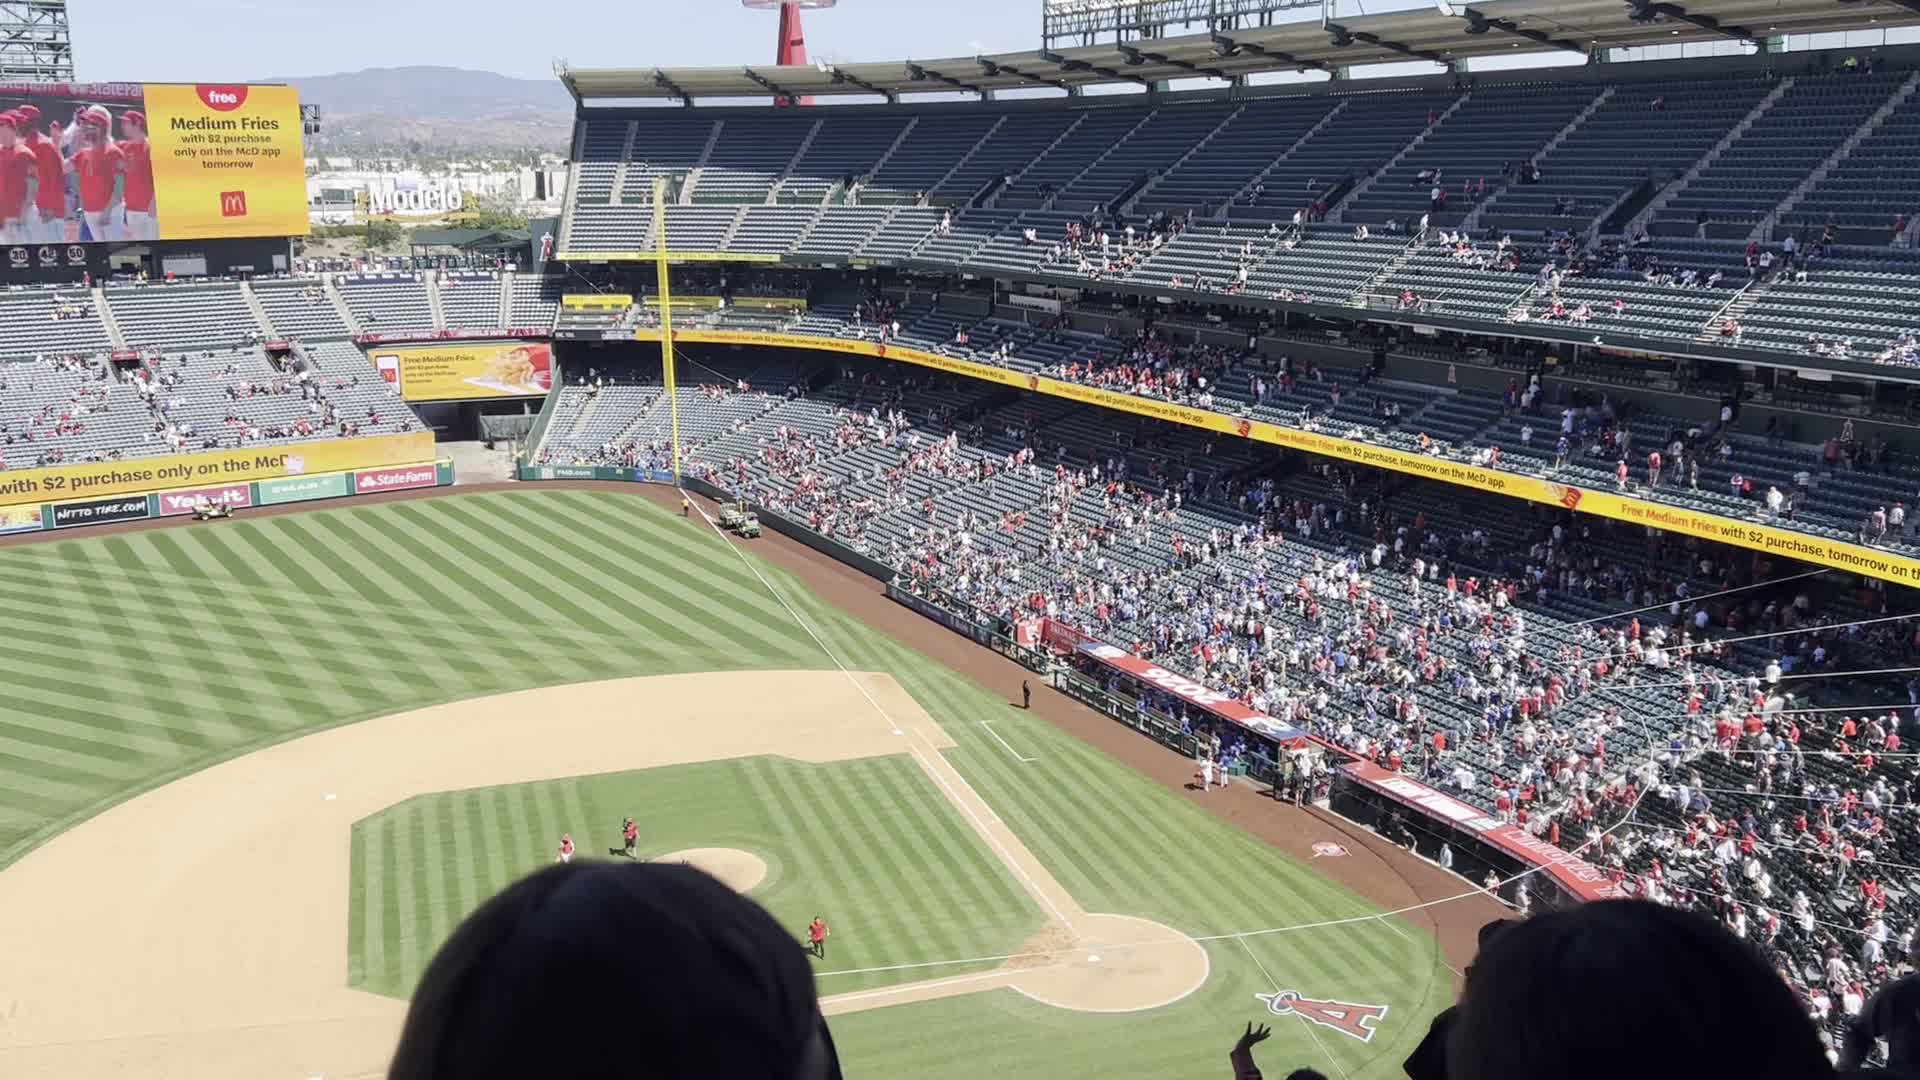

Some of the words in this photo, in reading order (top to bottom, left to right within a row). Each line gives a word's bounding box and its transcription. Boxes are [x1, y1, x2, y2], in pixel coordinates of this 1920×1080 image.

[208, 90, 237, 103] free
[171, 116, 236, 130] Medium
[241, 116, 279, 130] Fries
[181, 134, 205, 143] with
[208, 134, 221, 143] $2
[224, 134, 272, 144] purchase
[174, 148, 197, 158] only
[216, 147, 233, 156] the
[236, 147, 259, 156] McD
[261, 148, 281, 157] app
[202, 160, 254, 169] tomorrow
[368, 178, 462, 211] Modelo
[1336, 444, 1352, 455] with
[1353, 447, 1362, 457] $2
[1400, 457, 1438, 473] tomorrow
[1440, 467, 1450, 476] on
[1452, 468, 1465, 480] the
[1467, 471, 1486, 483] McD
[0, 479, 38, 495] with
[44, 476, 65, 491] $2
[71, 469, 152, 491] purchase
[157, 463, 193, 480] only
[197, 462, 219, 475] on
[223, 458, 250, 472] the
[57, 504, 92, 520] NITTO
[1621, 503, 1643, 515] Free
[1646, 509, 1689, 527] Medium
[1691, 517, 1718, 534] Fries
[1721, 525, 1746, 540] with
[1749, 530, 1764, 543] $2
[1766, 536, 1826, 558] purchase,
[1828, 547, 1889, 573] tomorrow
[1891, 564, 1908, 577] on
